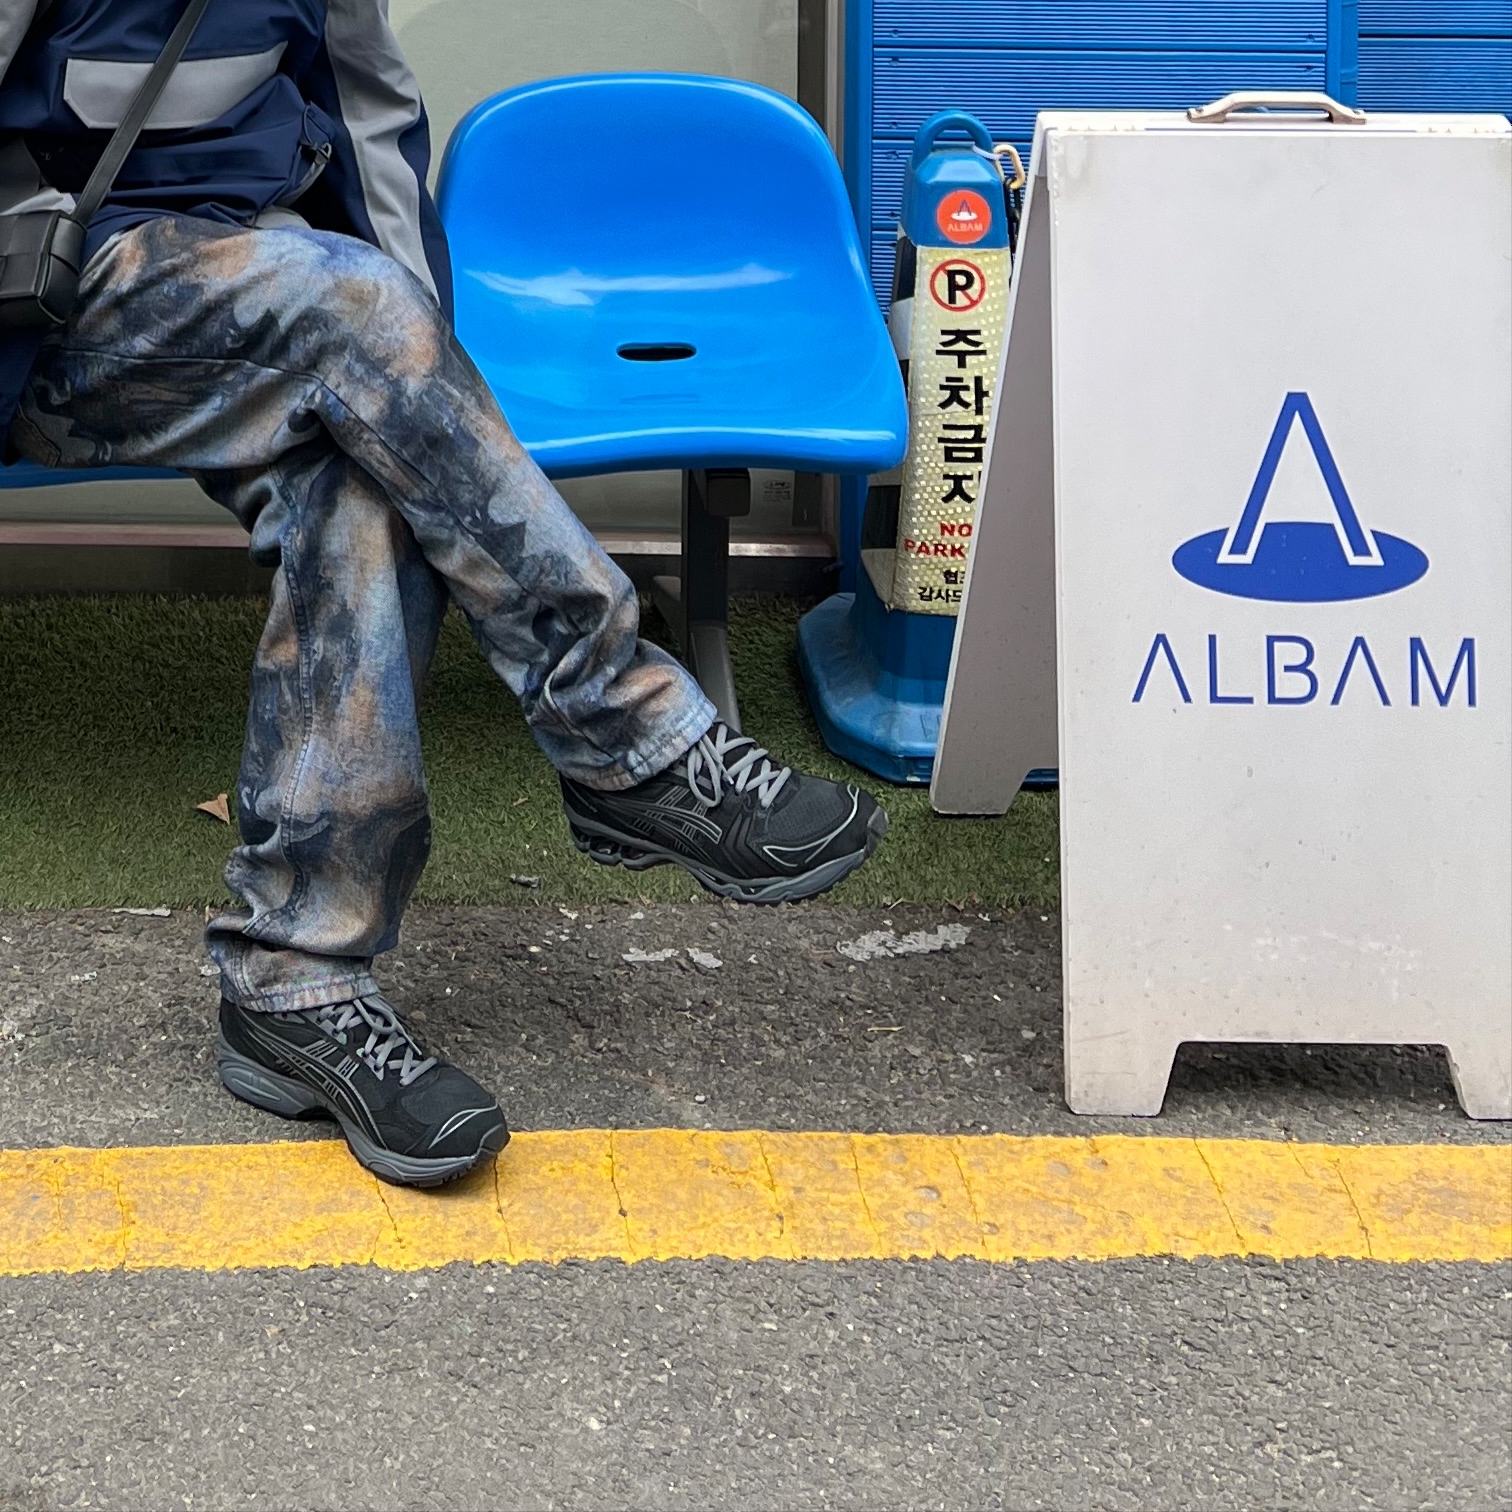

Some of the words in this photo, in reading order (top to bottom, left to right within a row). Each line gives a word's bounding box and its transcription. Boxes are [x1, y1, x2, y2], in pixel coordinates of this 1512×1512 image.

[947, 223, 983, 232] ALBAM
[940, 523, 972, 537] NO
[904, 538, 966, 558] PARK
[1131, 633, 1477, 708] ALBAM
